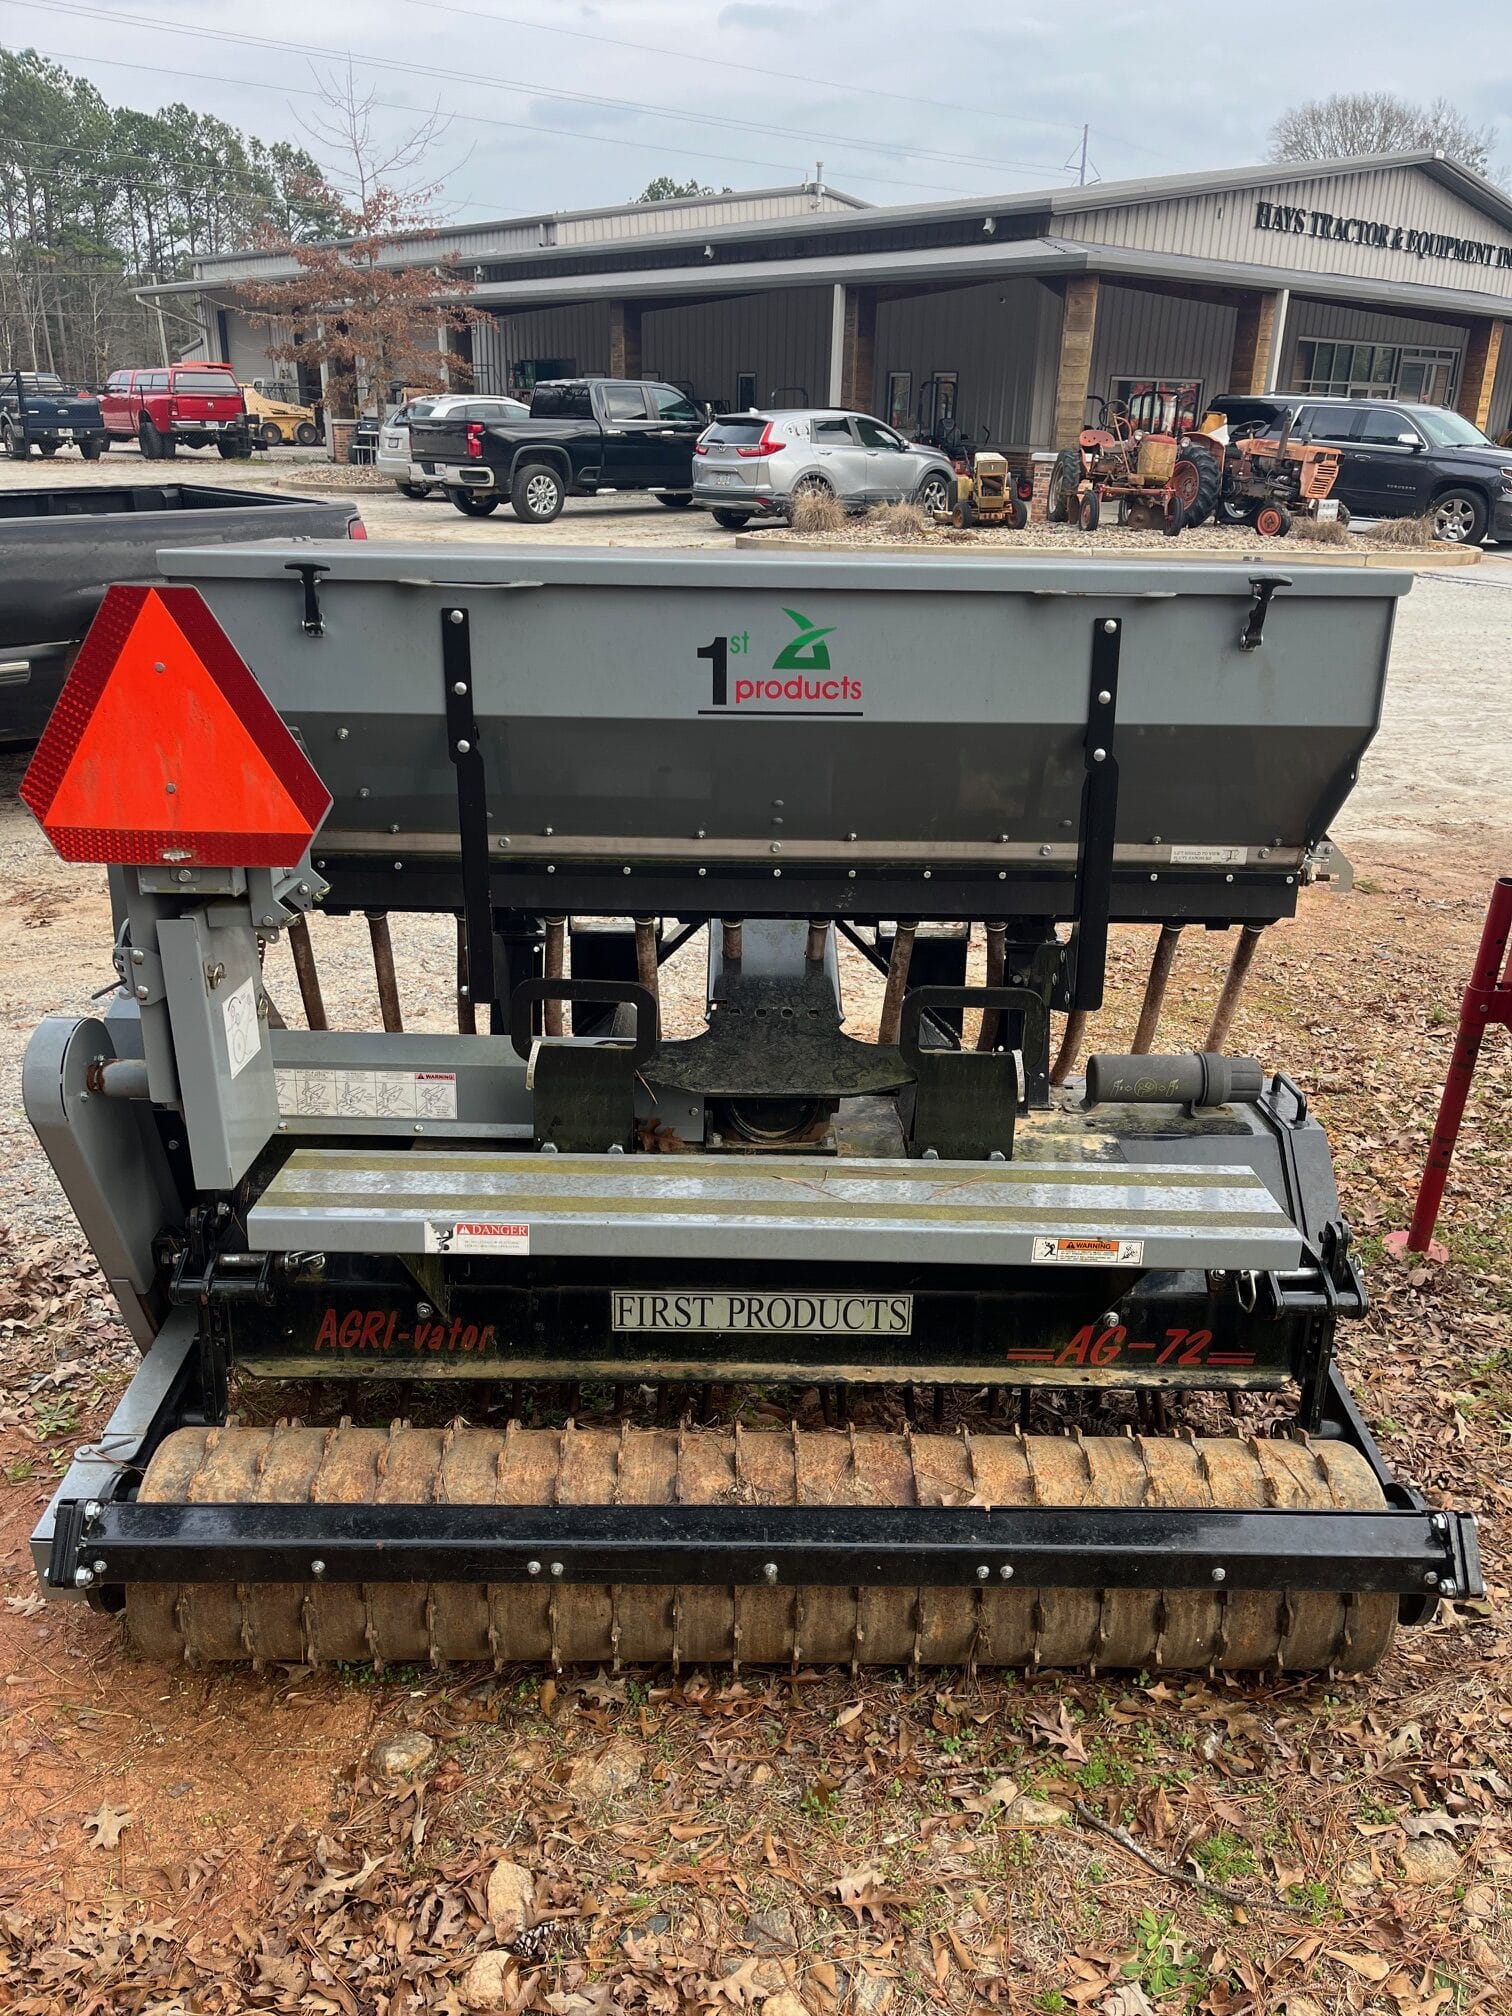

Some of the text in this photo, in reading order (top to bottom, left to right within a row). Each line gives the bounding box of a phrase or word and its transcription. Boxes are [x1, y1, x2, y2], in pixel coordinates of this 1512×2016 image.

[1255, 202, 1306, 235] HAYS
[1311, 211, 1390, 249] TRACTOR
[1391, 227, 1404, 251] &
[1406, 229, 1496, 266] EQUIPMENT
[735, 675, 863, 704] products
[472, 1225, 527, 1236] DANGER
[1076, 1242, 1111, 1250] WARNING
[314, 1308, 496, 1351] AGRI-vator
[615, 1296, 908, 1331] FIRST PRODUCTS
[1055, 1325, 1213, 1366] AG-72
